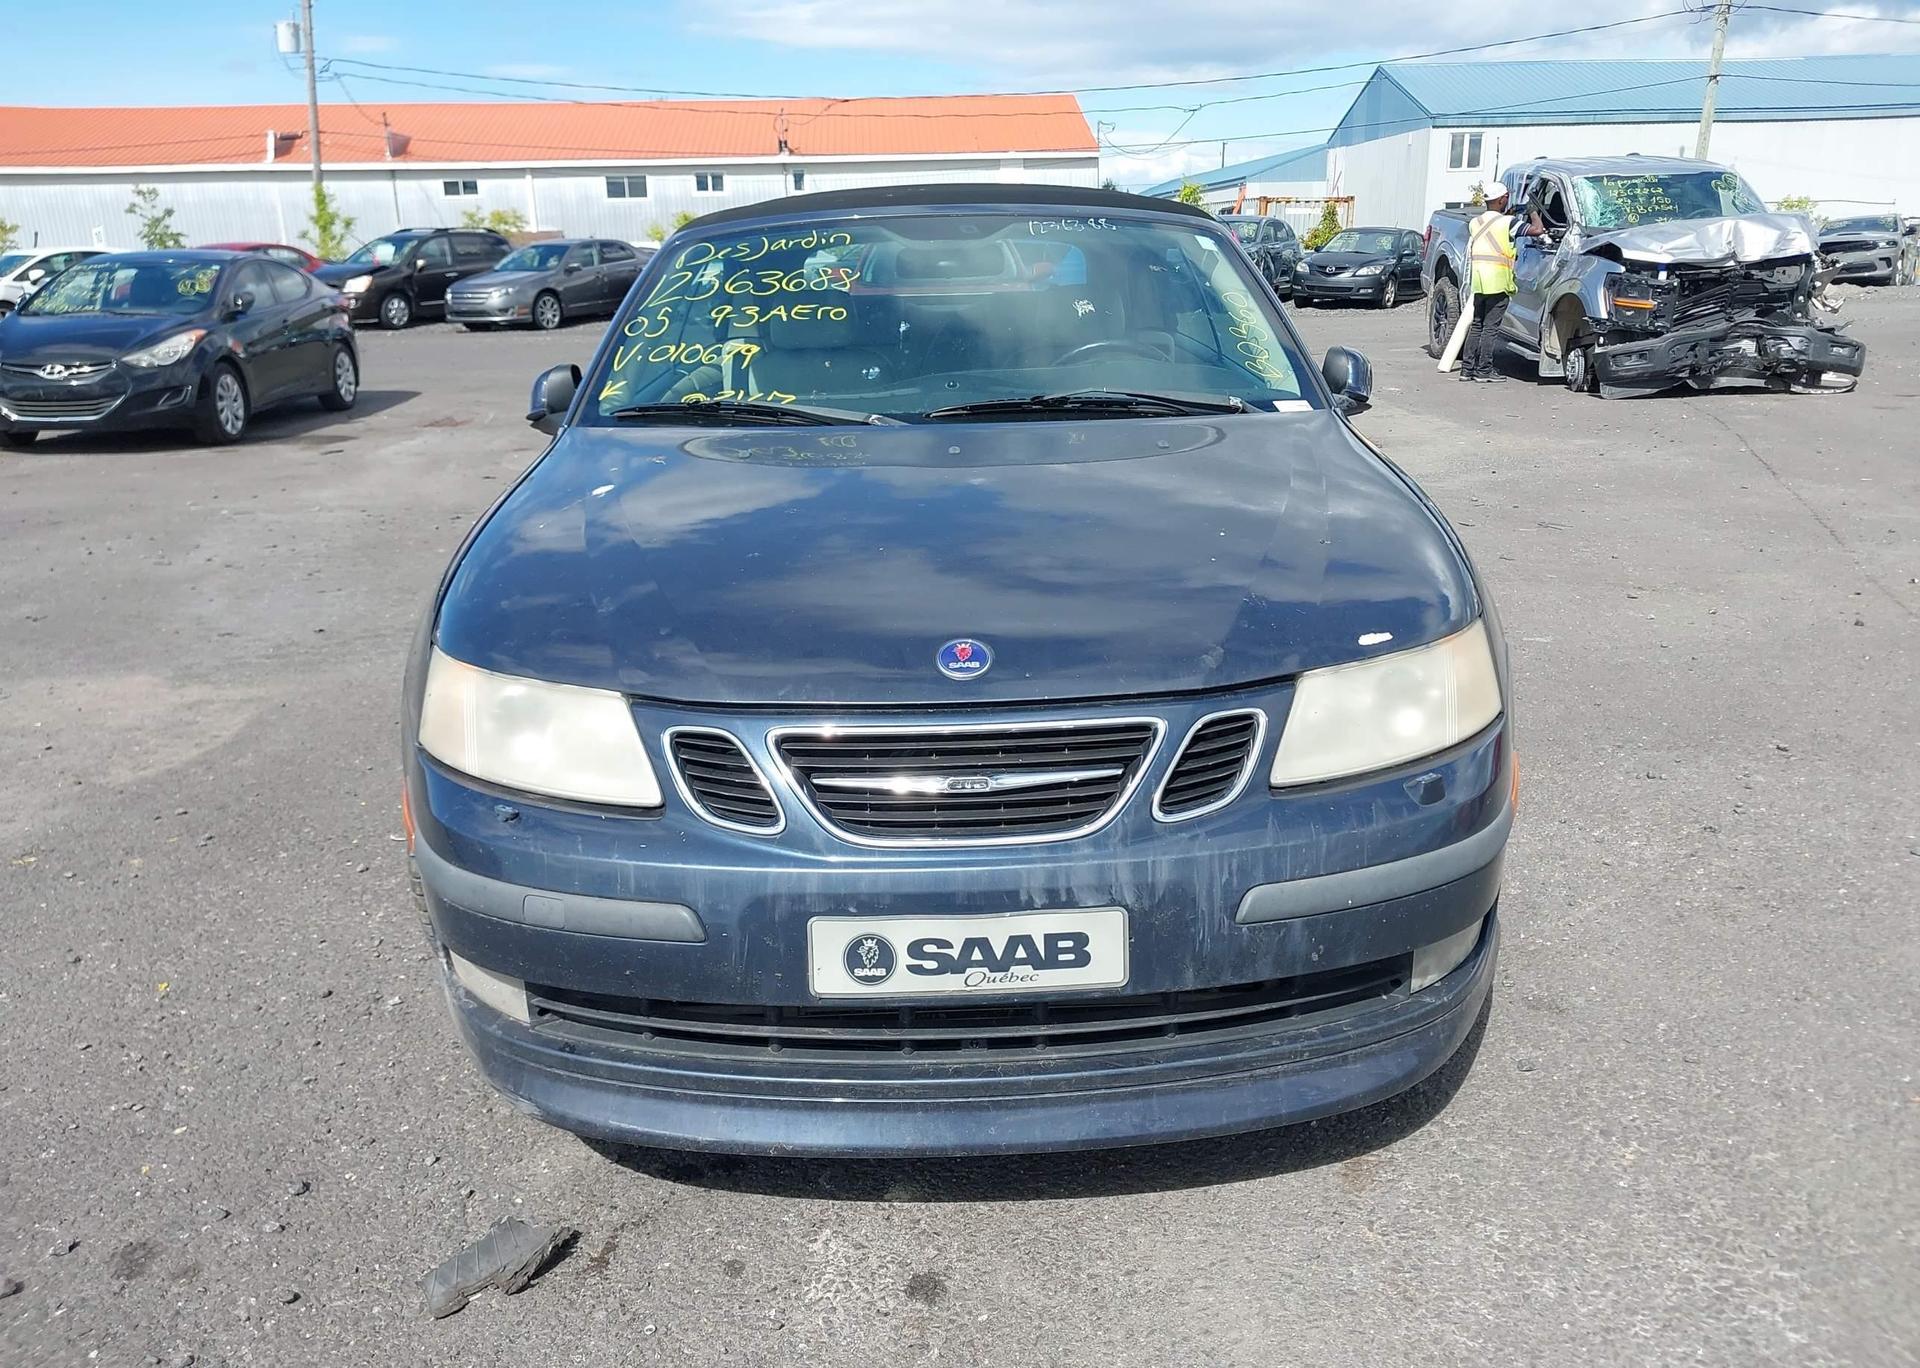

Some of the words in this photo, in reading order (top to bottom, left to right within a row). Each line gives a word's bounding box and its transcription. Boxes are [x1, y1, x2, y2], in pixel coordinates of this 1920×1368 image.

[638, 266, 860, 311] 12363688
[624, 306, 672, 338] 05
[948, 661, 980, 669] SAAB
[905, 931, 1092, 977] SAAB
[853, 967, 887, 977] SAAB
[963, 971, 1040, 989] Québec
